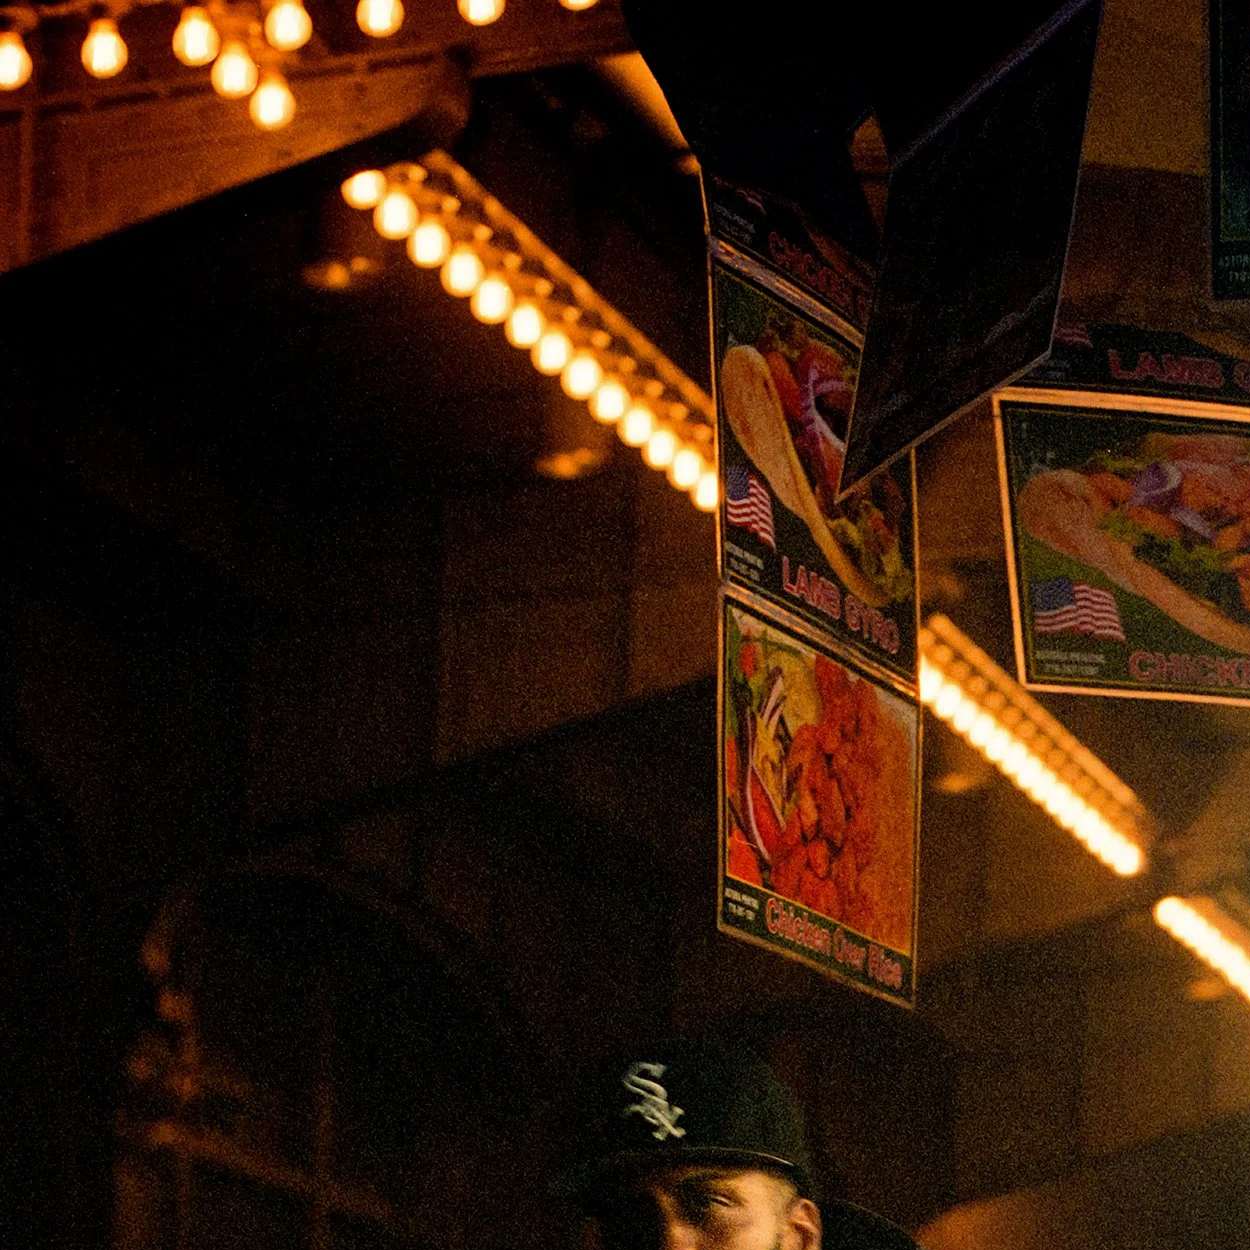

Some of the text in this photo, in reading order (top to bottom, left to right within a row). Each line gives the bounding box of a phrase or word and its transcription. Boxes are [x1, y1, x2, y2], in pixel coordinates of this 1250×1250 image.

[1107, 348, 1226, 389] LAMB
[782, 555, 841, 620] LAMB
[844, 593, 900, 655] GYRO
[765, 897, 831, 957] Chicken
